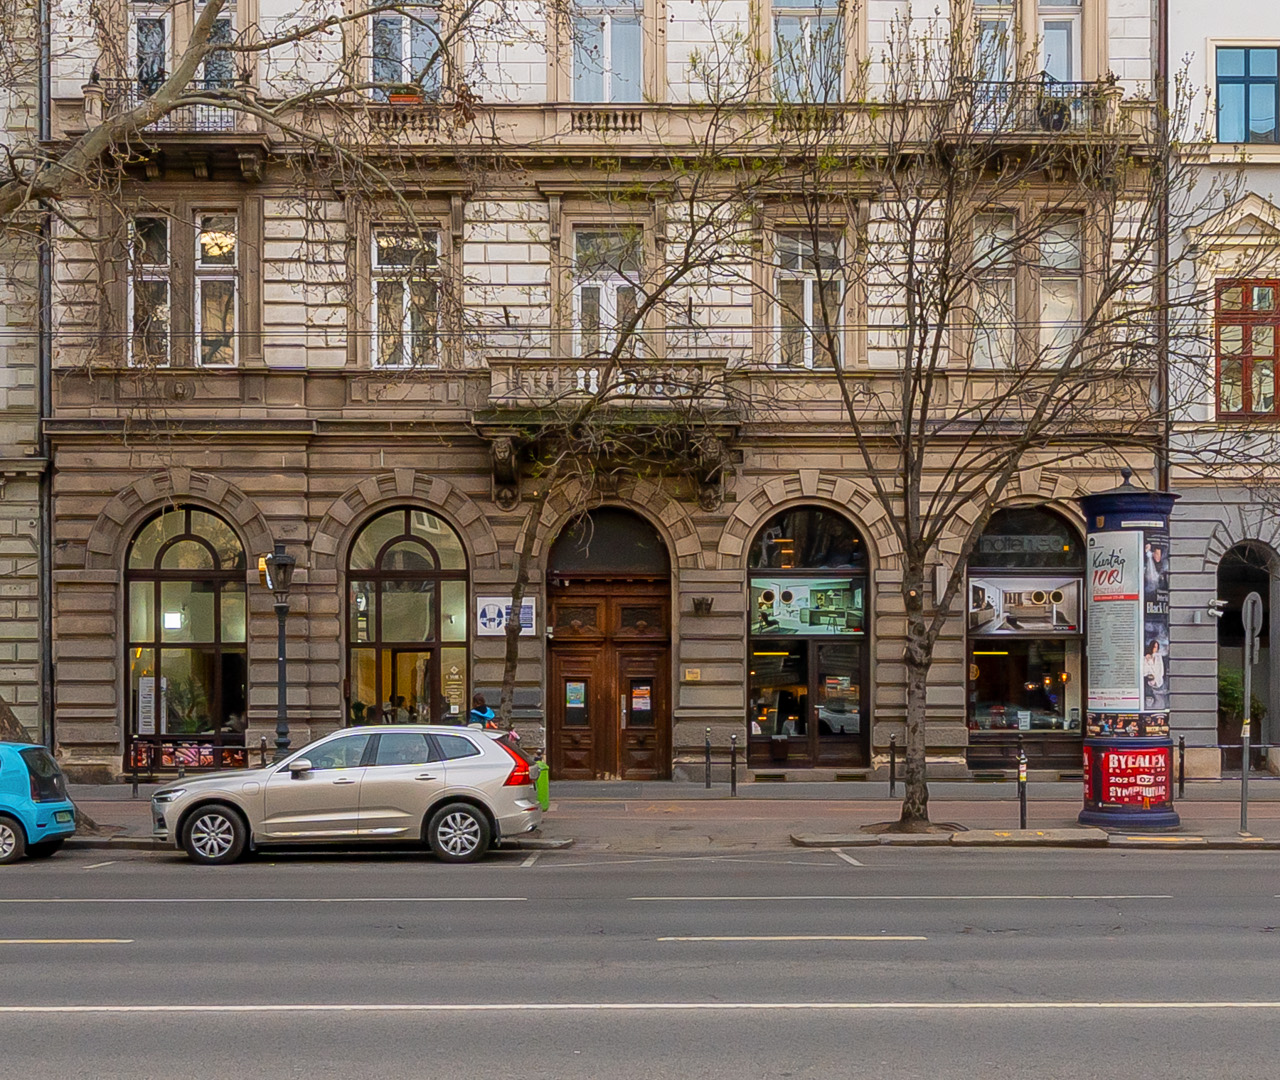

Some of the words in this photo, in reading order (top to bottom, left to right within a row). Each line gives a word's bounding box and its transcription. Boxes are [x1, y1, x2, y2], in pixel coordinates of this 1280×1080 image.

[1093, 569, 1120, 586] 100
[1147, 602, 1162, 613] Black
[1109, 754, 1165, 768] BYEALEX
